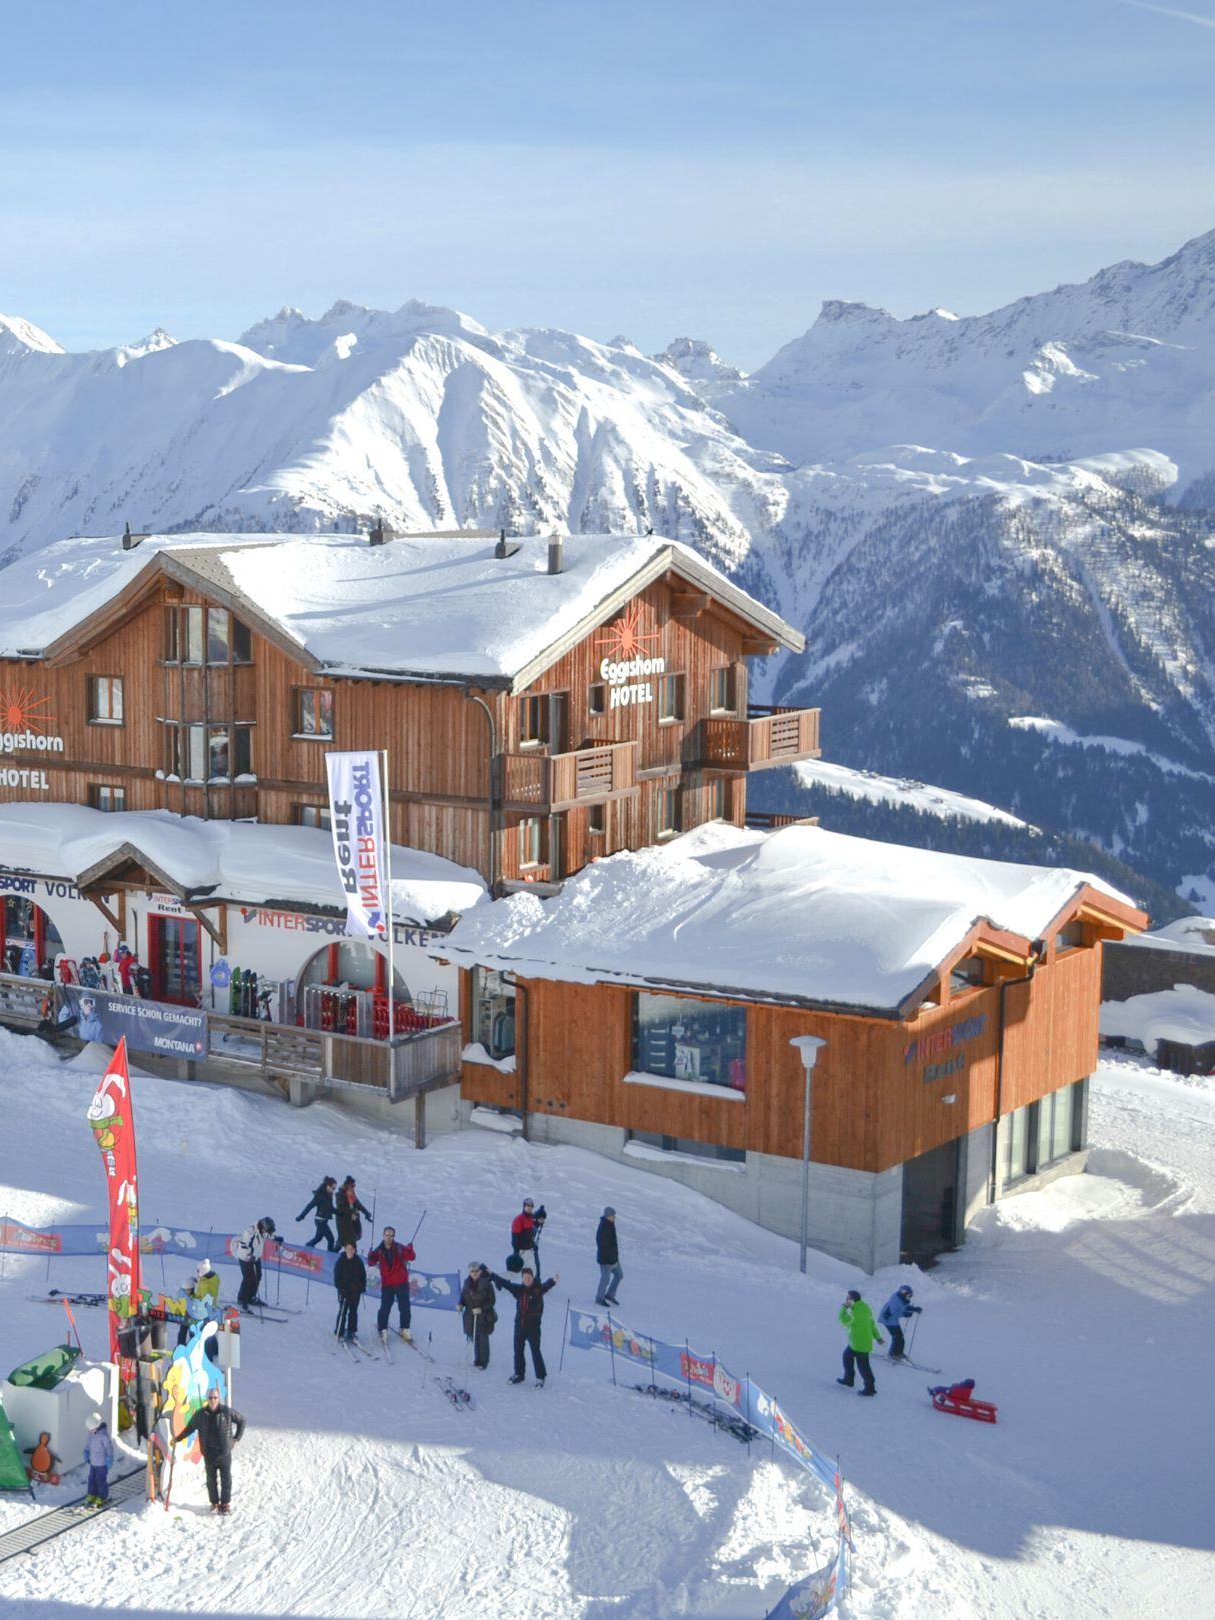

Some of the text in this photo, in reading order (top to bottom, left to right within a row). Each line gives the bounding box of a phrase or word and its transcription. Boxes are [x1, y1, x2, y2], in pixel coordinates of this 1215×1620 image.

[600, 655, 665, 685] Eggishorn
[610, 683, 652, 709] HOTEL
[158, 903, 182, 913] Rent
[259, 913, 352, 937] INTERSPOR
[108, 1002, 137, 1015] SERVICE
[163, 1012, 202, 1027] GEMACHT?
[154, 1036, 195, 1053] MONTANA
